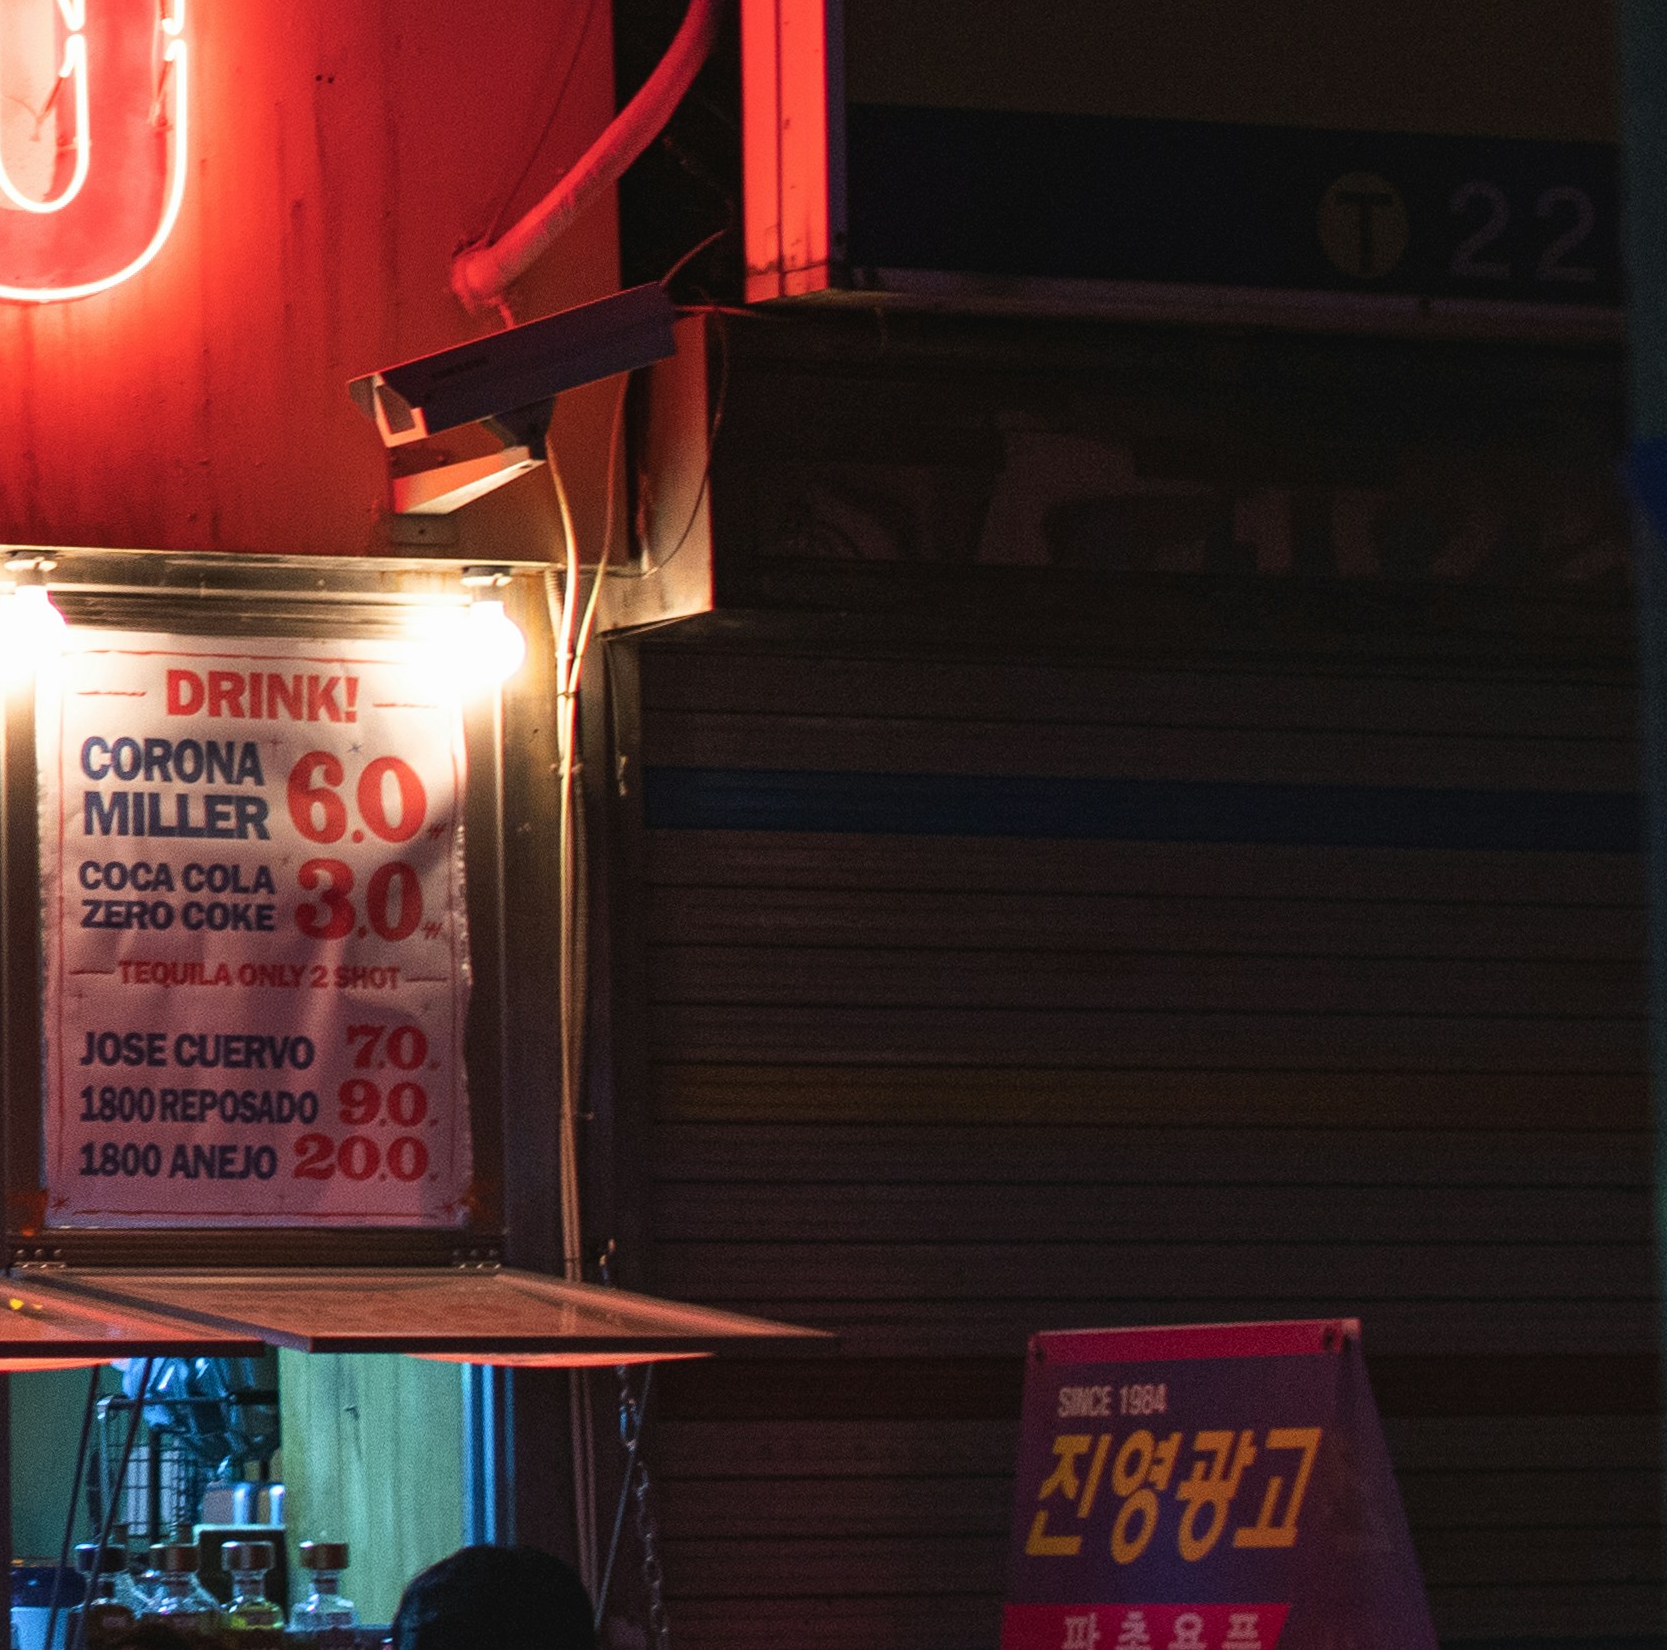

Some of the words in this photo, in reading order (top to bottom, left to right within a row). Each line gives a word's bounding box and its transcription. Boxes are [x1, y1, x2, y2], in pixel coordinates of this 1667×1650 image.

[167, 669, 360, 724] DRINK!
[81, 736, 265, 787] CORONA
[83, 791, 271, 840] MILLER
[287, 750, 427, 844] 6.0
[79, 860, 176, 892] COCA
[181, 862, 276, 894] COLA
[80, 899, 173, 929] ZERO
[181, 901, 275, 932] COKE
[295, 858, 423, 942] 3.0
[119, 960, 232, 988] TEQUILA
[237, 962, 308, 988] ONLY
[311, 965, 331, 988] 2
[335, 966, 402, 990] SHOT
[80, 1032, 167, 1067] JOSE
[173, 1033, 315, 1070] CUERVO
[80, 1086, 156, 1123] 1800
[160, 1088, 320, 1124] REPOSADO
[79, 1142, 161, 1177] 1800
[169, 1143, 278, 1180] ANEJO
[1058, 1386, 1112, 1417] SINCE
[1118, 1383, 1167, 1414] 1984
[1025, 1427, 1323, 1564] 진영광고
